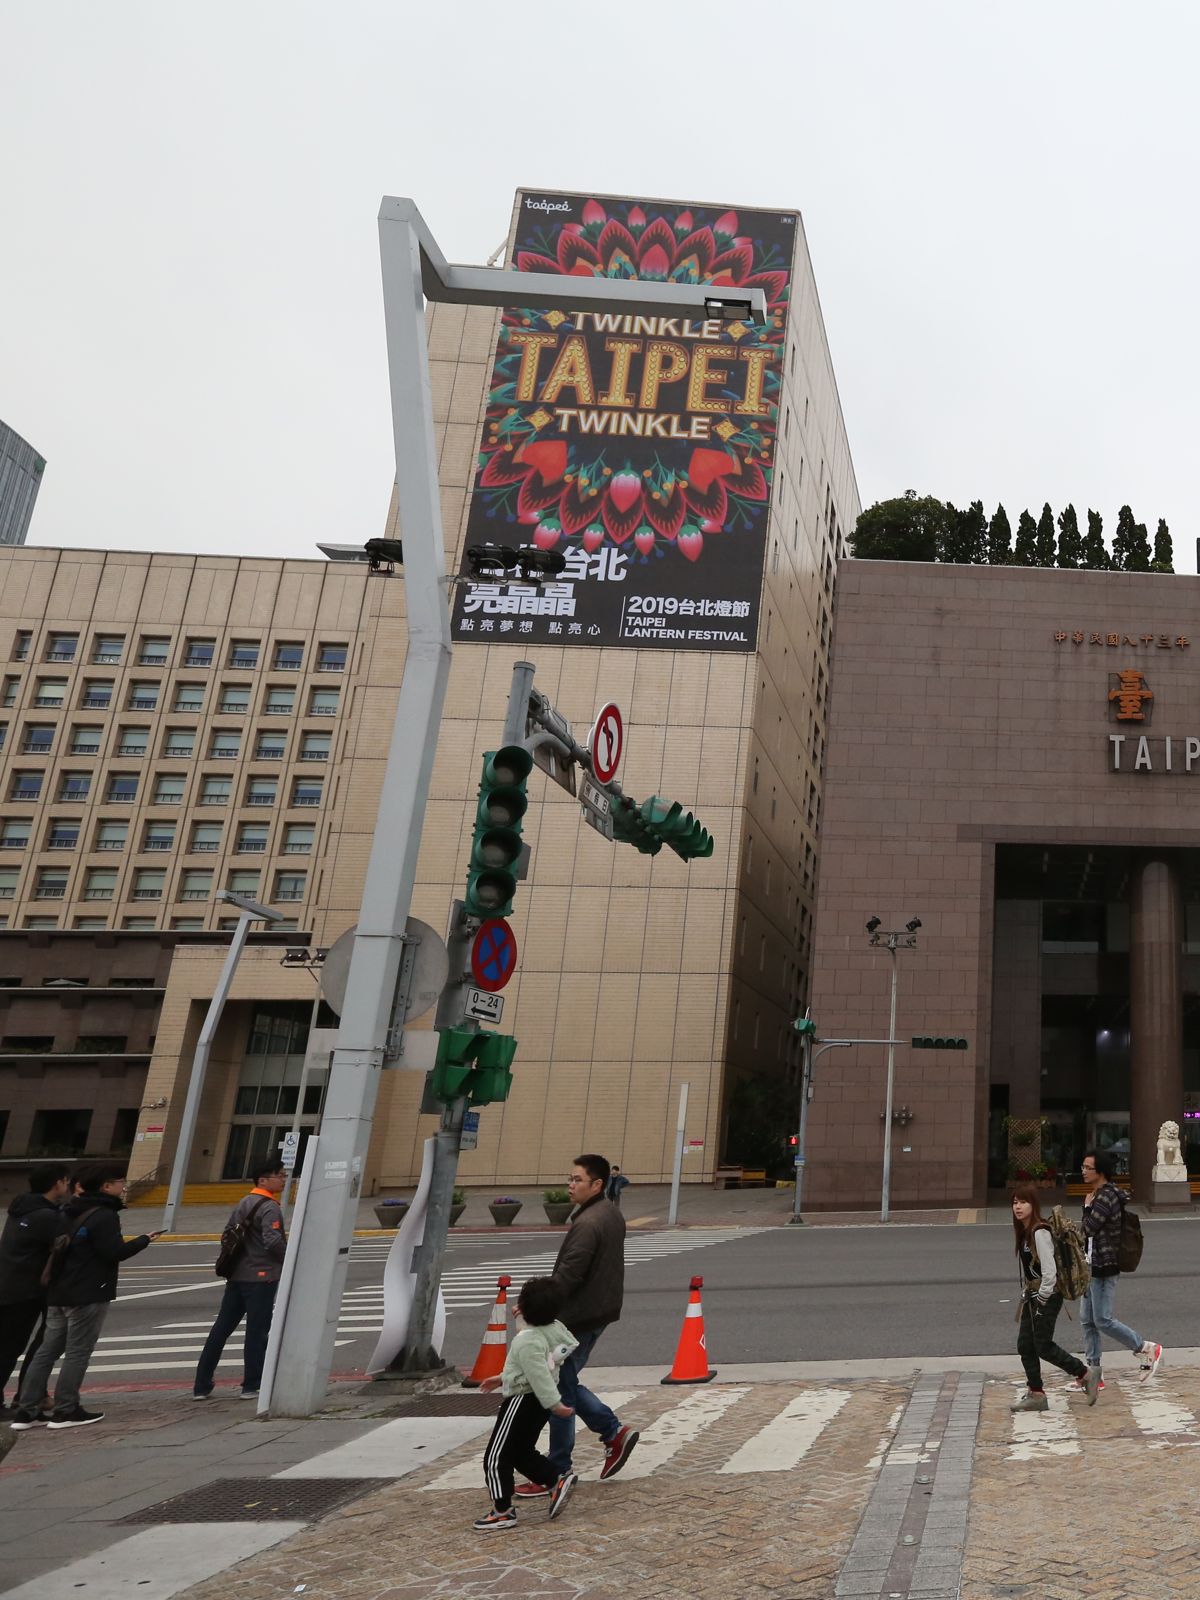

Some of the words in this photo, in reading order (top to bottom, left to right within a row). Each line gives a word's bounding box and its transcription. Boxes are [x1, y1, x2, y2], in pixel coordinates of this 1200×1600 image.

[571, 312, 722, 339] TWINKLE
[509, 331, 775, 415] TAIPEI
[554, 407, 711, 439] TWINKLE
[463, 582, 577, 616] 亮晶晶
[628, 596, 750, 617] 2019台北燈節
[624, 628, 685, 639] LANTERN
[688, 630, 748, 641] FESTIVAL
[626, 616, 666, 627] TAIPEI
